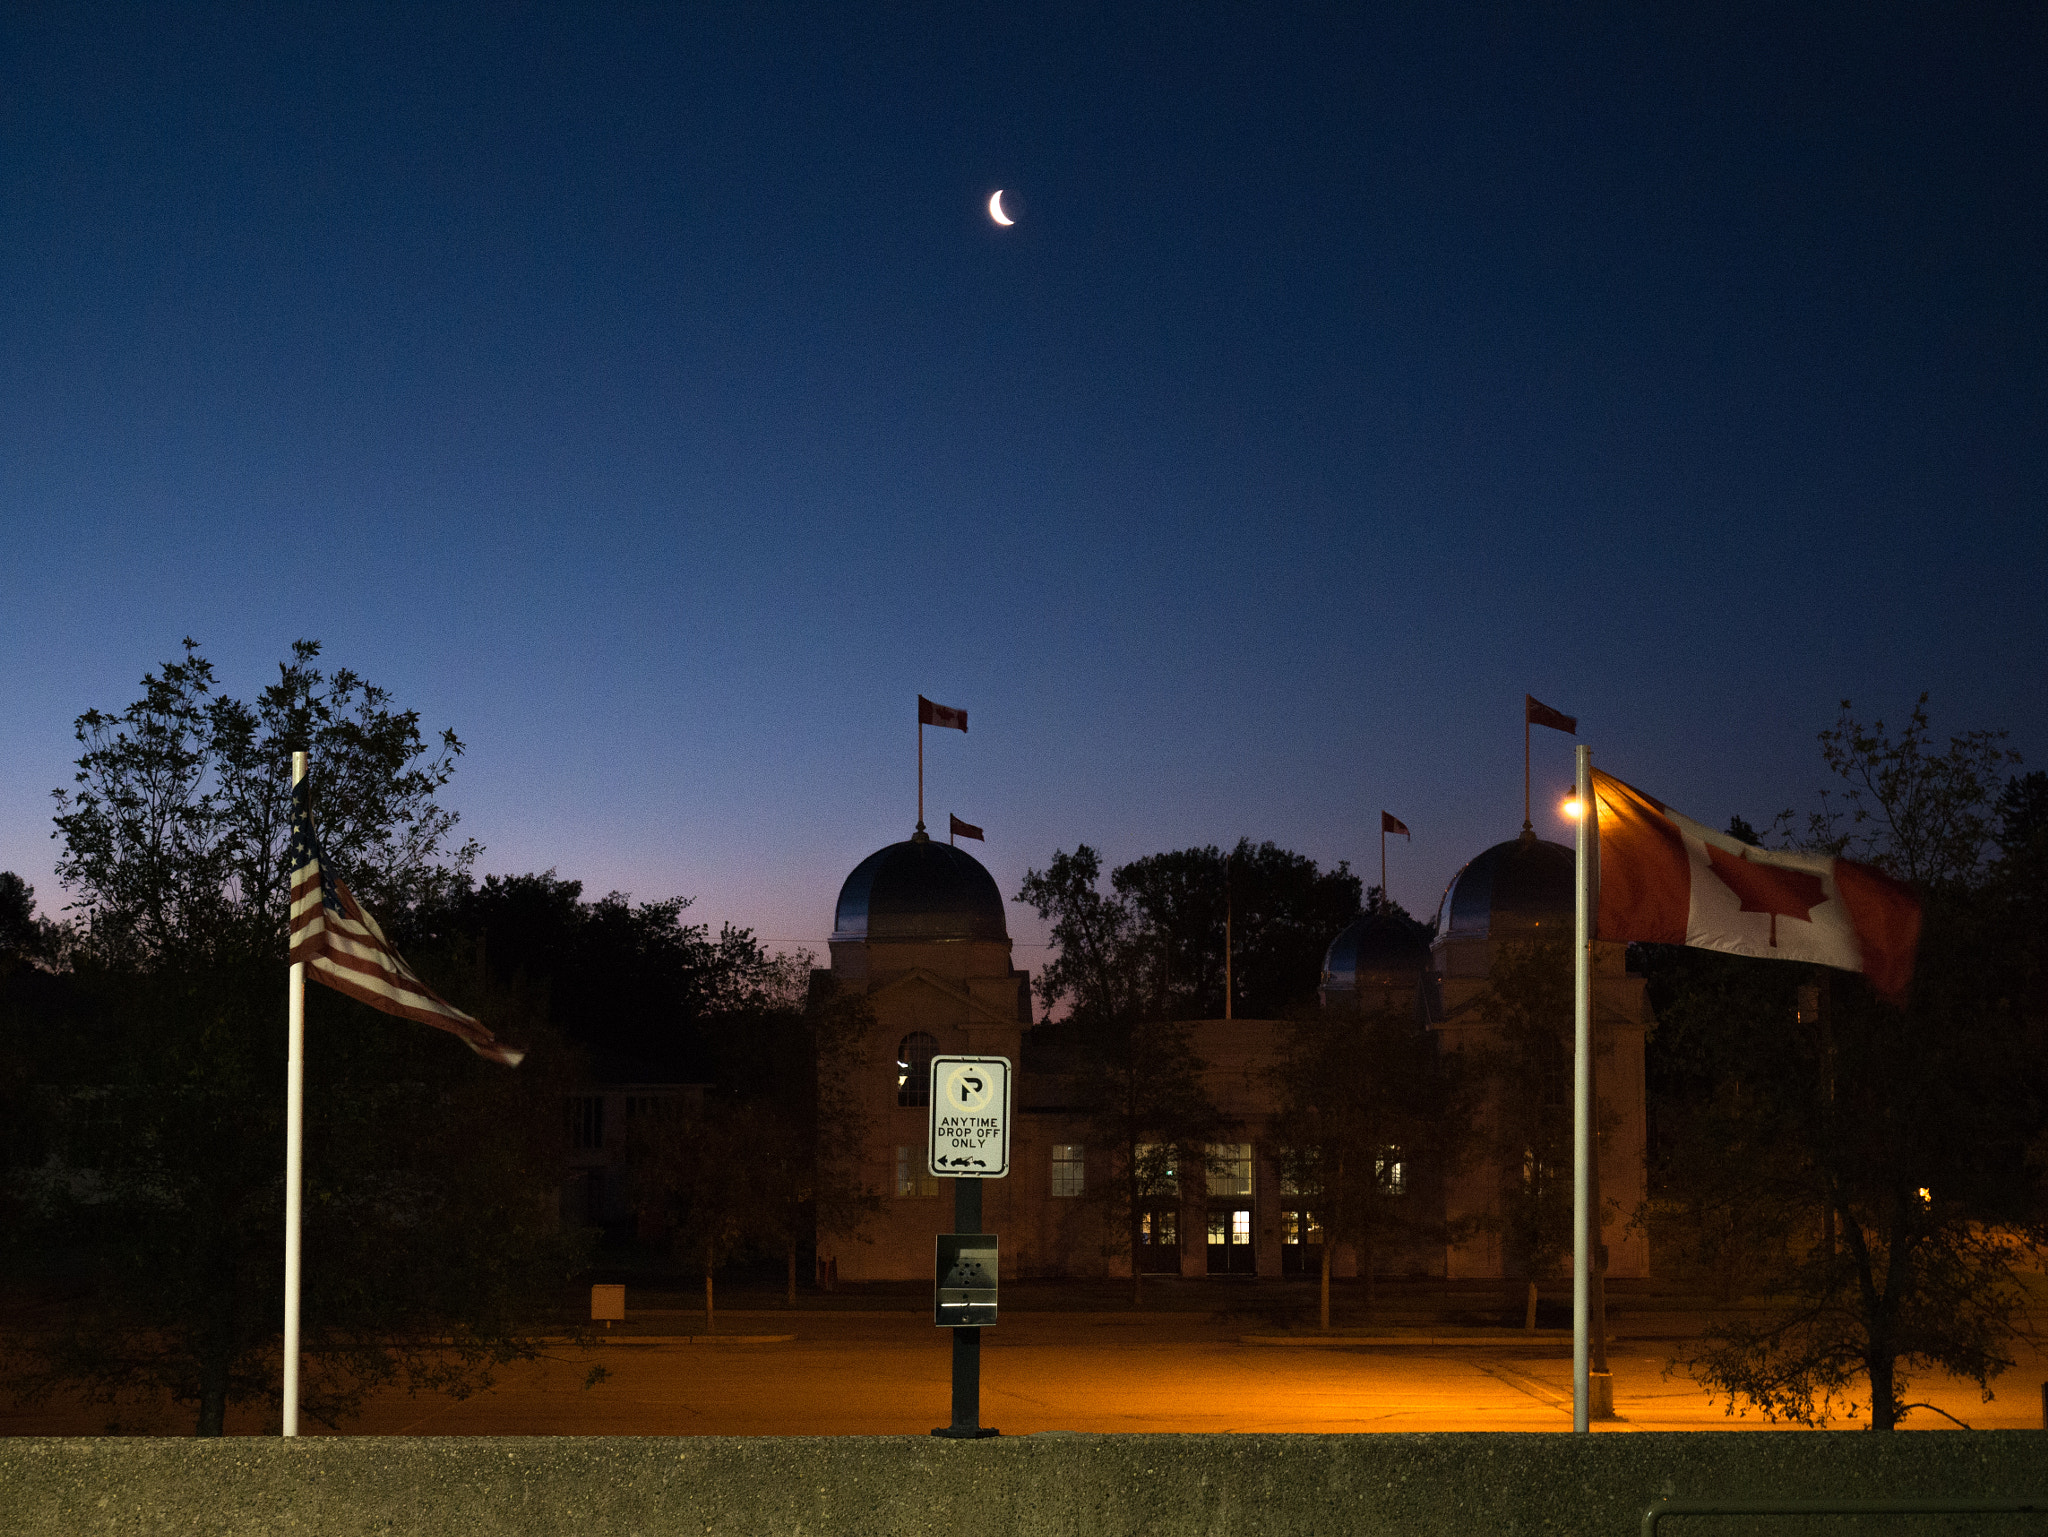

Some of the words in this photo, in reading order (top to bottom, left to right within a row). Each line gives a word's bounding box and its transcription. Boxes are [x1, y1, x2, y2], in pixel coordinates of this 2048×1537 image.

[941, 1117, 998, 1127] ANYTIME
[938, 1128, 972, 1137] DROP
[977, 1128, 1001, 1138] OFF
[952, 1138, 986, 1148] ONLY
